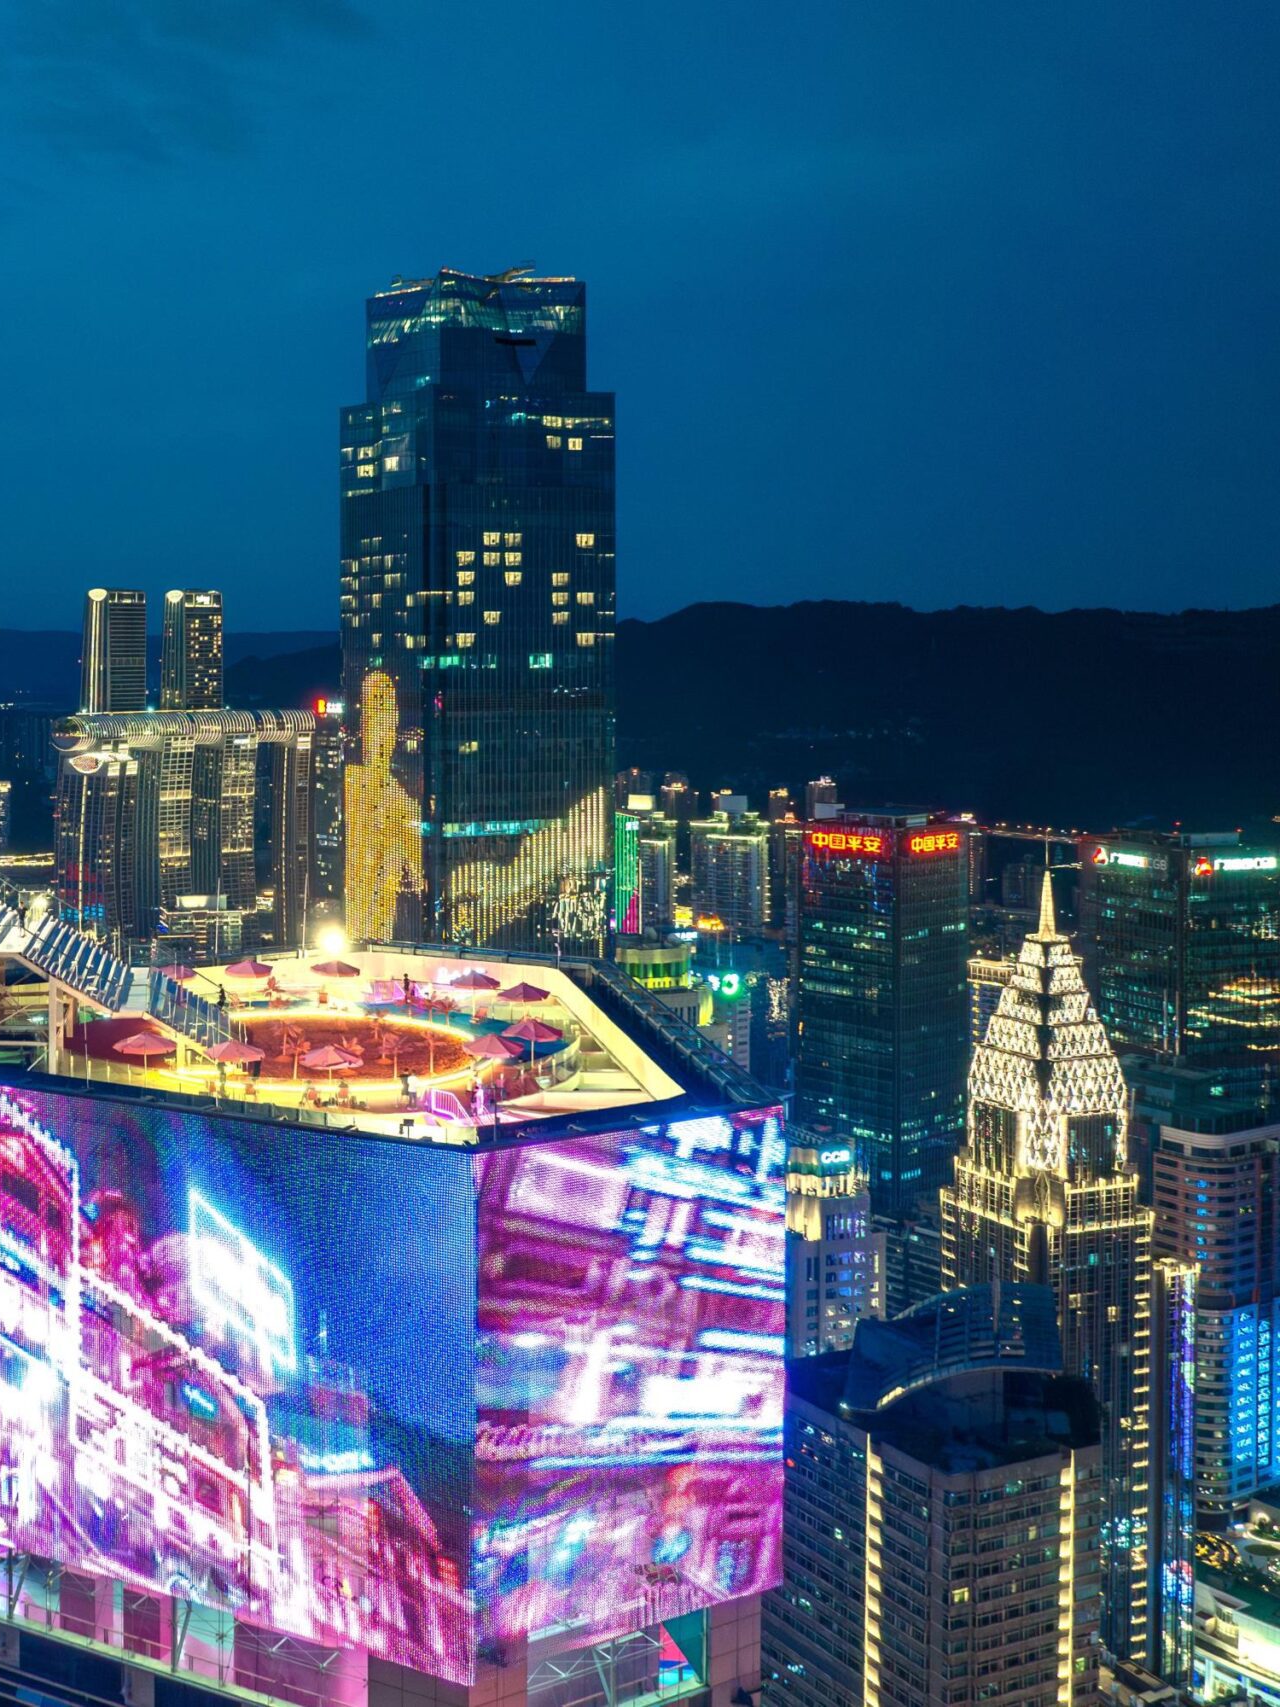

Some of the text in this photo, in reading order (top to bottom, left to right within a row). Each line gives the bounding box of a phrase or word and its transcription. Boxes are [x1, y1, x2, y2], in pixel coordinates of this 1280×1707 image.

[812, 832, 881, 853] 中国平安
[911, 833, 959, 852] 中国平安
